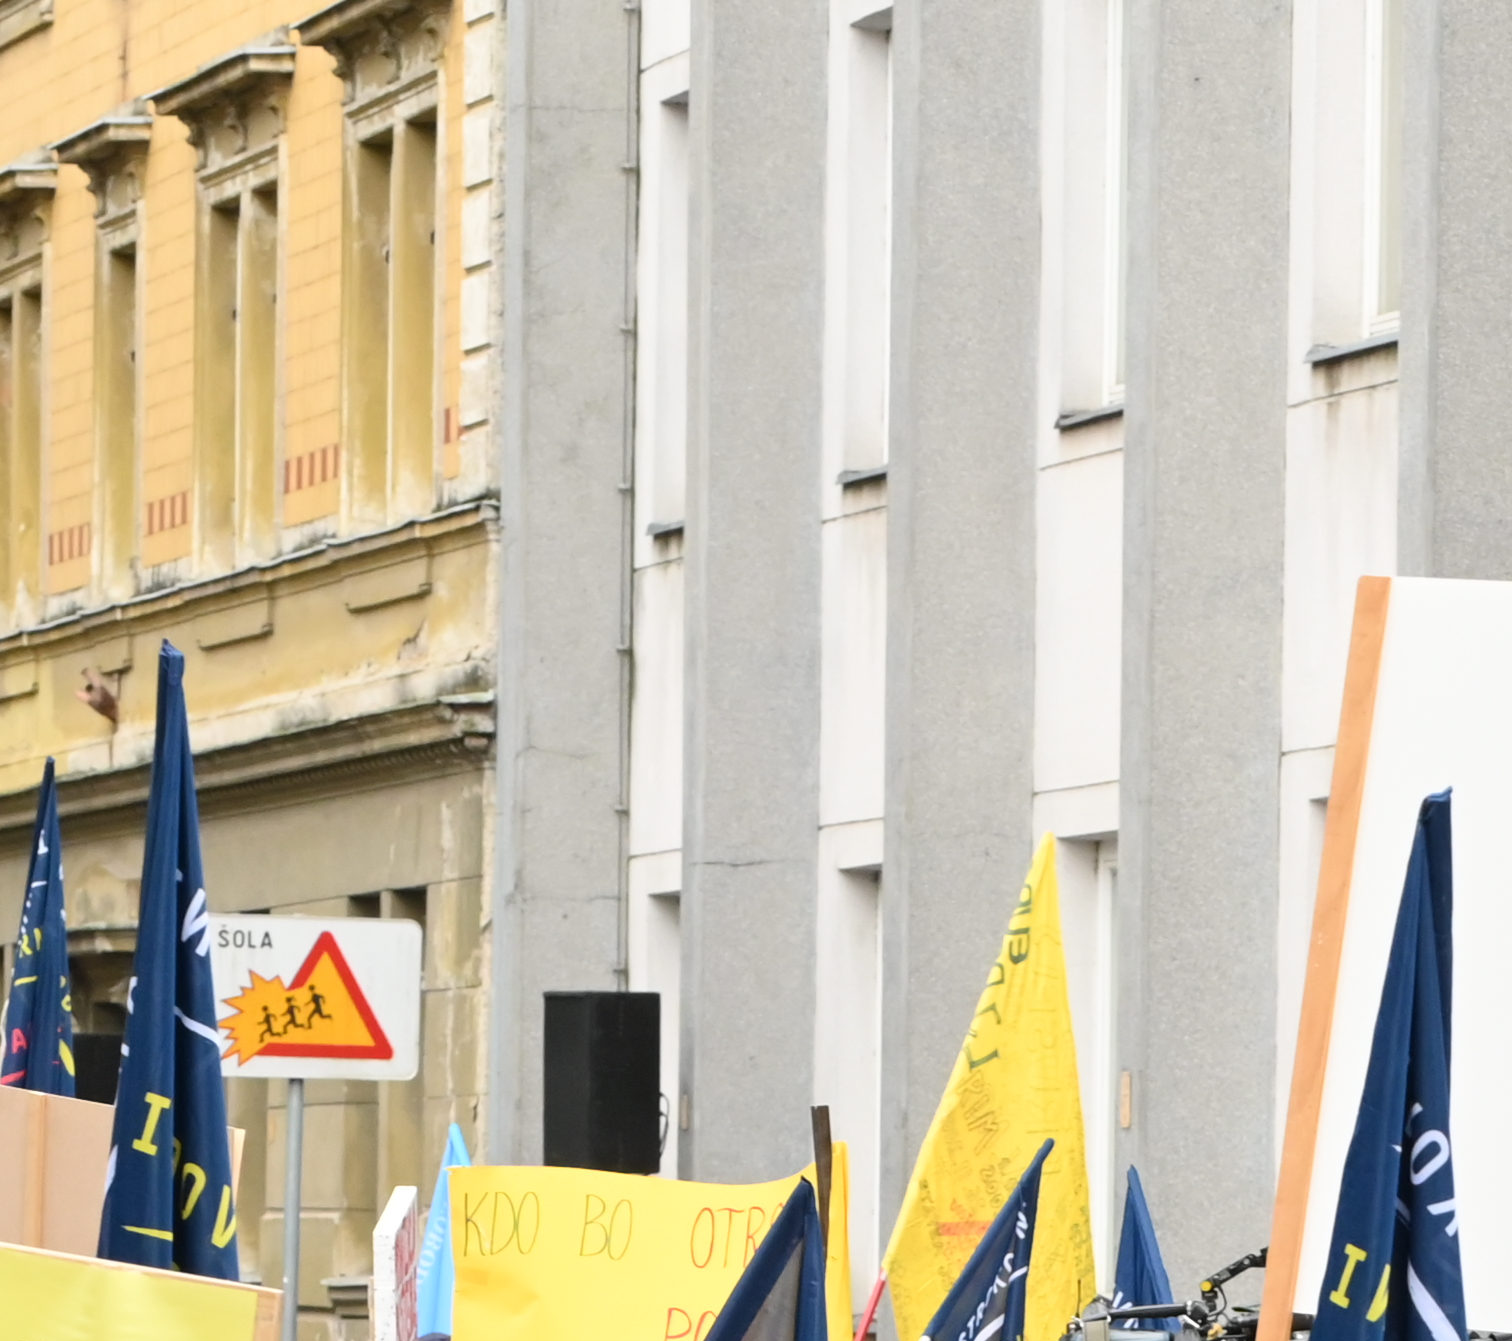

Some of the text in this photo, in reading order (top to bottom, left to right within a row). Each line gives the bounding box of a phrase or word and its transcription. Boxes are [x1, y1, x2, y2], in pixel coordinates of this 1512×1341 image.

[217, 923, 274, 950] ŠOLA
[463, 1190, 540, 1257] KDO
[579, 1193, 633, 1260] BO
[691, 1202, 787, 1268] OTR
